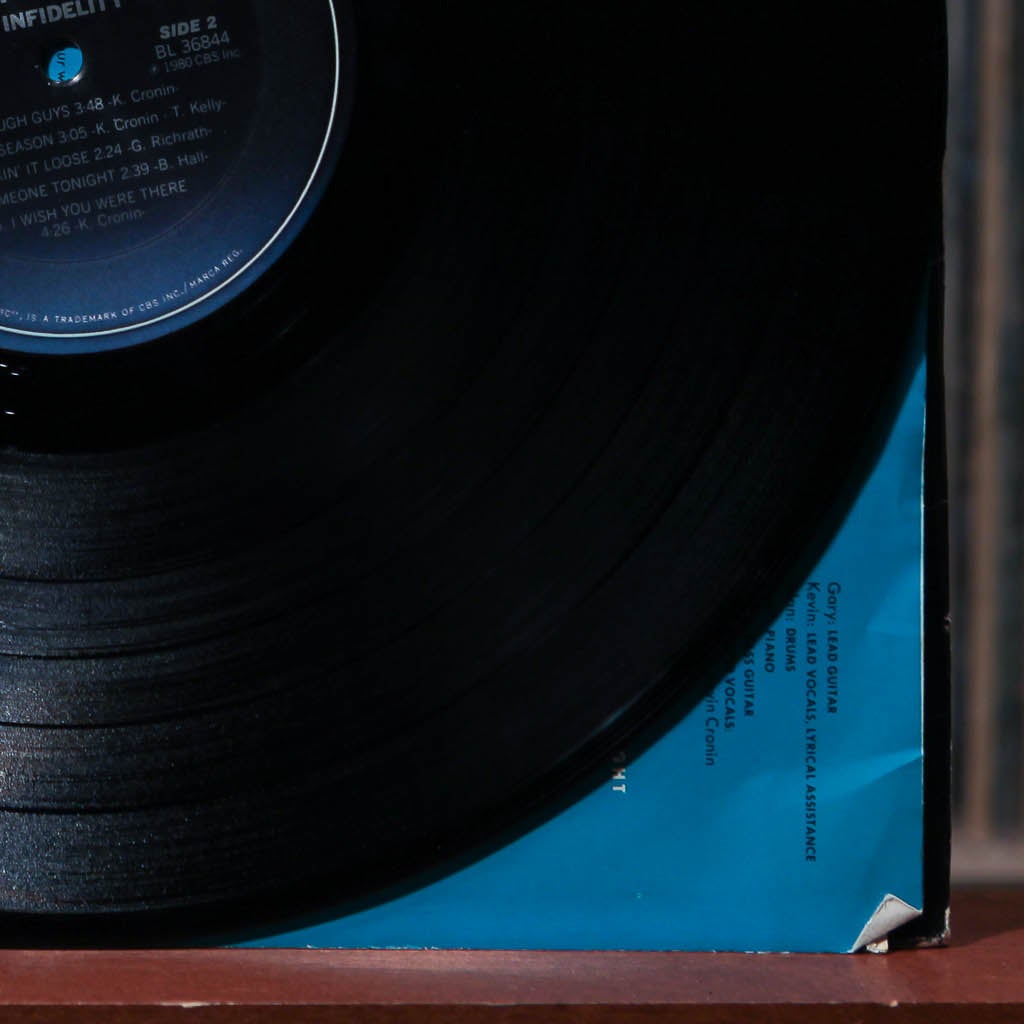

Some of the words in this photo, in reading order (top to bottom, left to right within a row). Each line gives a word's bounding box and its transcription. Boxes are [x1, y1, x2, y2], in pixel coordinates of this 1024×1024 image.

[154, 43, 176, 60] BL
[180, 31, 231, 54] 36844
[160, 20, 201, 40] SIDE
[206, 16, 217, 29] 2
[31, 105, 71, 124] GUYS
[26, 161, 39, 175] IT
[44, 152, 89, 172] LOOSE
[52, 171, 115, 194] TONIGHT
[20, 209, 57, 227] WISH
[61, 201, 91, 218] YOU
[95, 192, 136, 211] WERE
[141, 179, 188, 200] THERE
[55, 312, 117, 324] TRADEMARK
[138, 299, 159, 312] CBS
[805, 581, 820, 626] Kevin:
[824, 582, 841, 624] Gary:
[785, 628, 796, 672] DRUMS
[807, 633, 816, 664] LEAD
[827, 631, 838, 662] LEAD
[805, 670, 816, 724] VOCALS,
[827, 666, 838, 713] GUITAR
[805, 728, 816, 779] LYRICAL
[806, 784, 816, 862] ASSISTANCE
